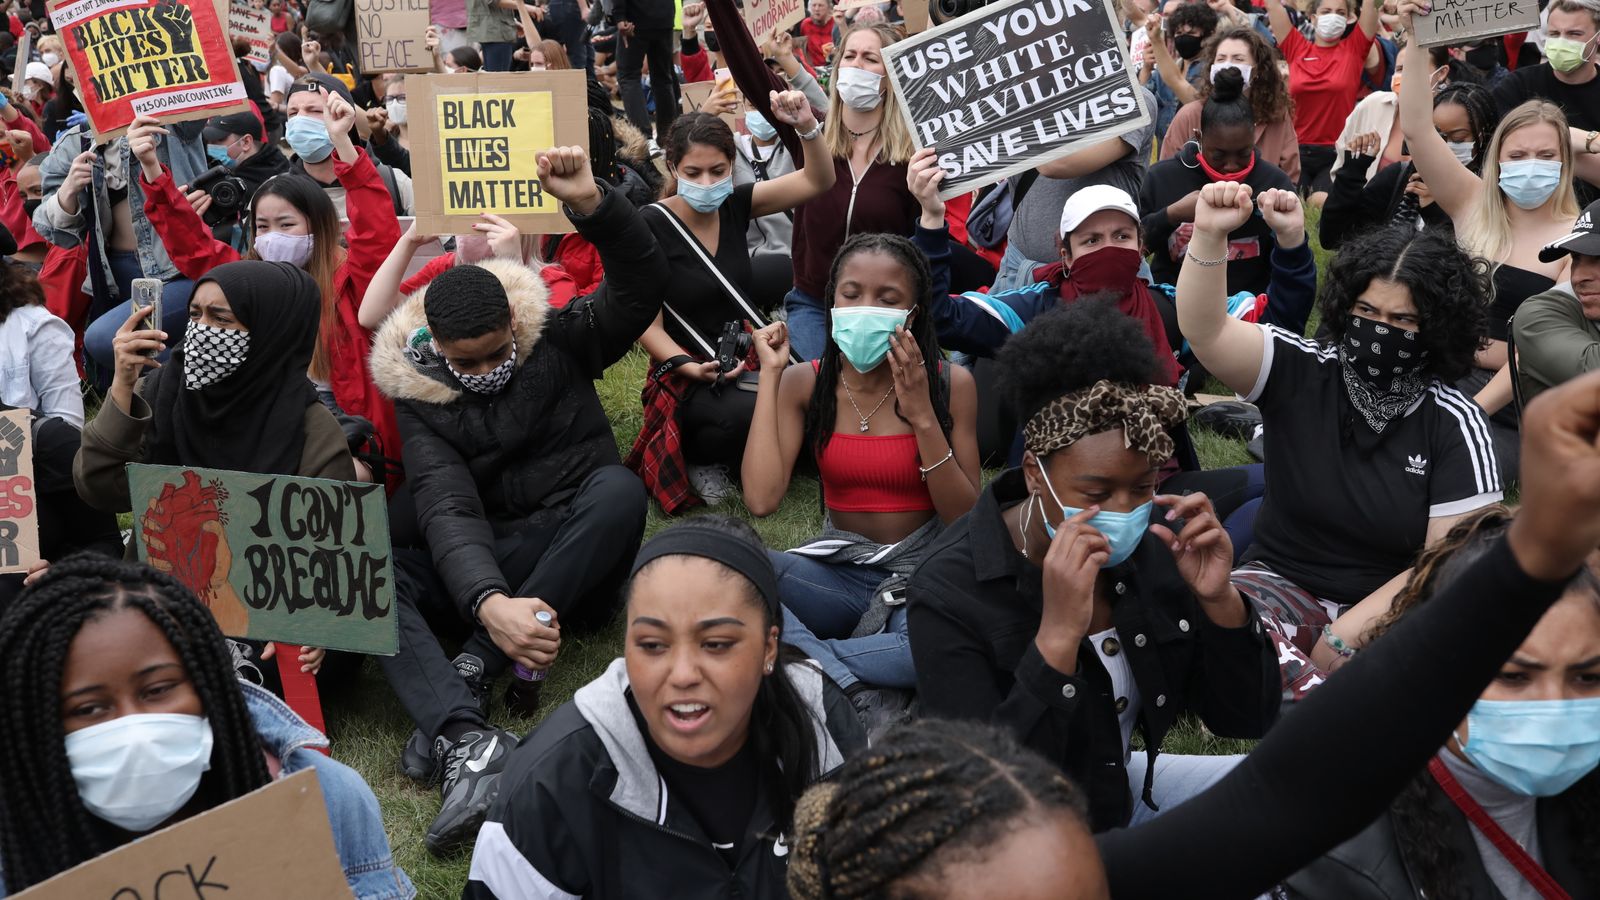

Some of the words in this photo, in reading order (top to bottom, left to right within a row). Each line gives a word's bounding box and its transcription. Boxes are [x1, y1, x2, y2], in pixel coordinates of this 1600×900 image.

[55, 15, 67, 25] THE
[66, 9, 75, 20] UK
[74, 6, 83, 16] IS
[82, 0, 94, 13] NOT
[71, 7, 158, 50] BLACK
[358, 13, 382, 38] NO
[1435, 2, 1525, 34] MATTER
[92, 30, 168, 71] LIVES
[361, 40, 418, 70] PEACE
[900, 31, 974, 80] USE
[982, 0, 1093, 45] YOUR
[88, 54, 209, 103] MATTER
[927, 30, 1075, 104] WHITE
[443, 99, 516, 130] BLACK
[917, 46, 1125, 147] PRIVILEGE
[937, 126, 1029, 179] SAVE
[1033, 86, 1136, 144] LIVES
[448, 138, 508, 169] LIVES
[449, 179, 544, 209] MATTER
[246, 477, 277, 538] I
